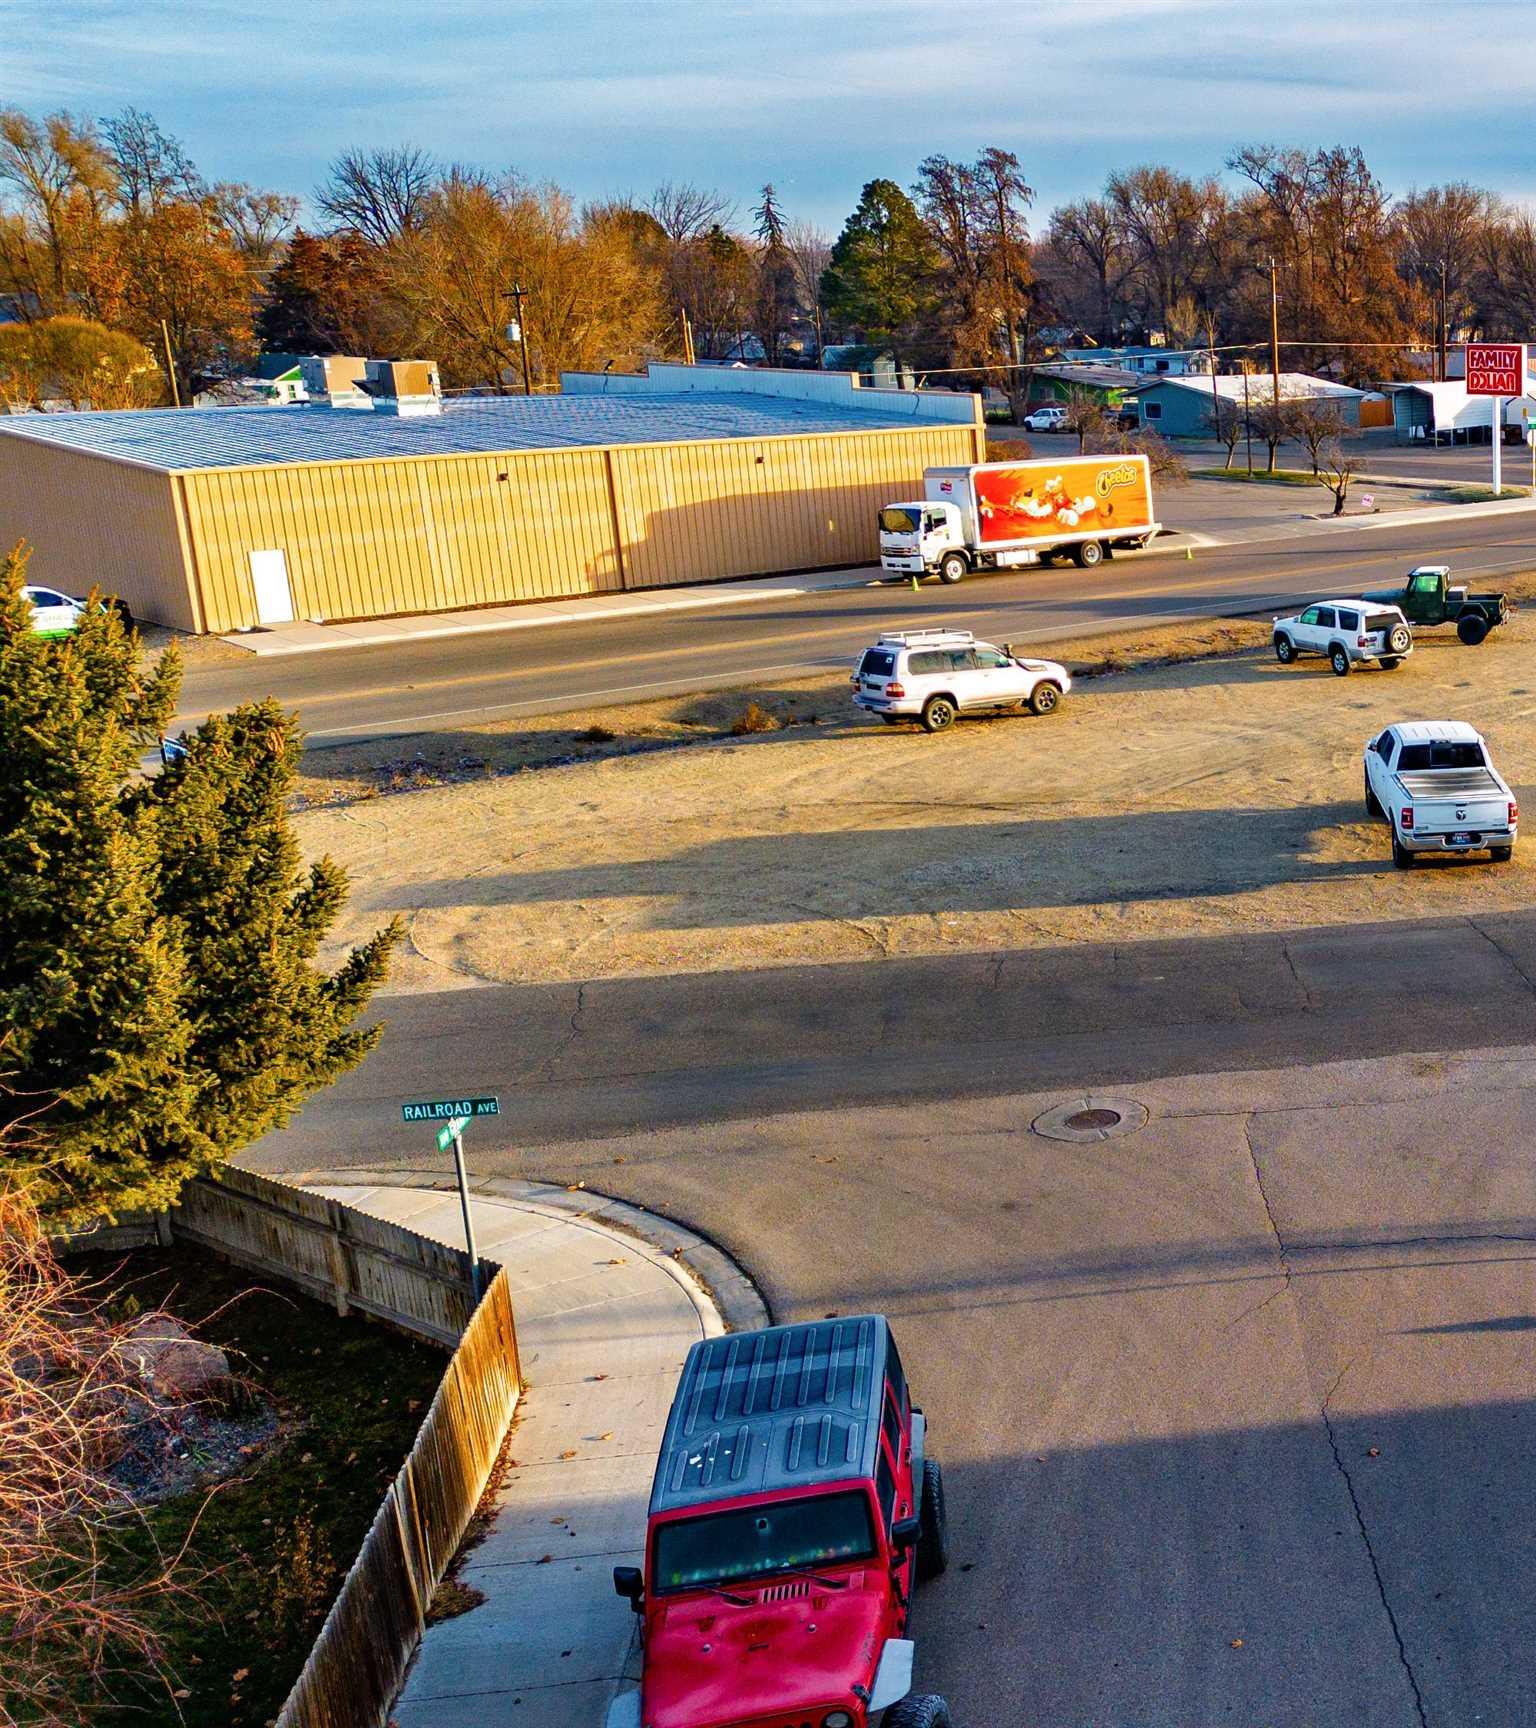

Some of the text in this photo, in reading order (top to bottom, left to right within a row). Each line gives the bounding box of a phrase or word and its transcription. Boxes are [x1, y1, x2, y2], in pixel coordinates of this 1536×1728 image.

[1469, 350, 1518, 369] FAMILY
[1469, 371, 1516, 391] DOLLAR
[1096, 464, 1137, 498] Cheetos
[404, 1101, 497, 1120] RAILROAD AVE
